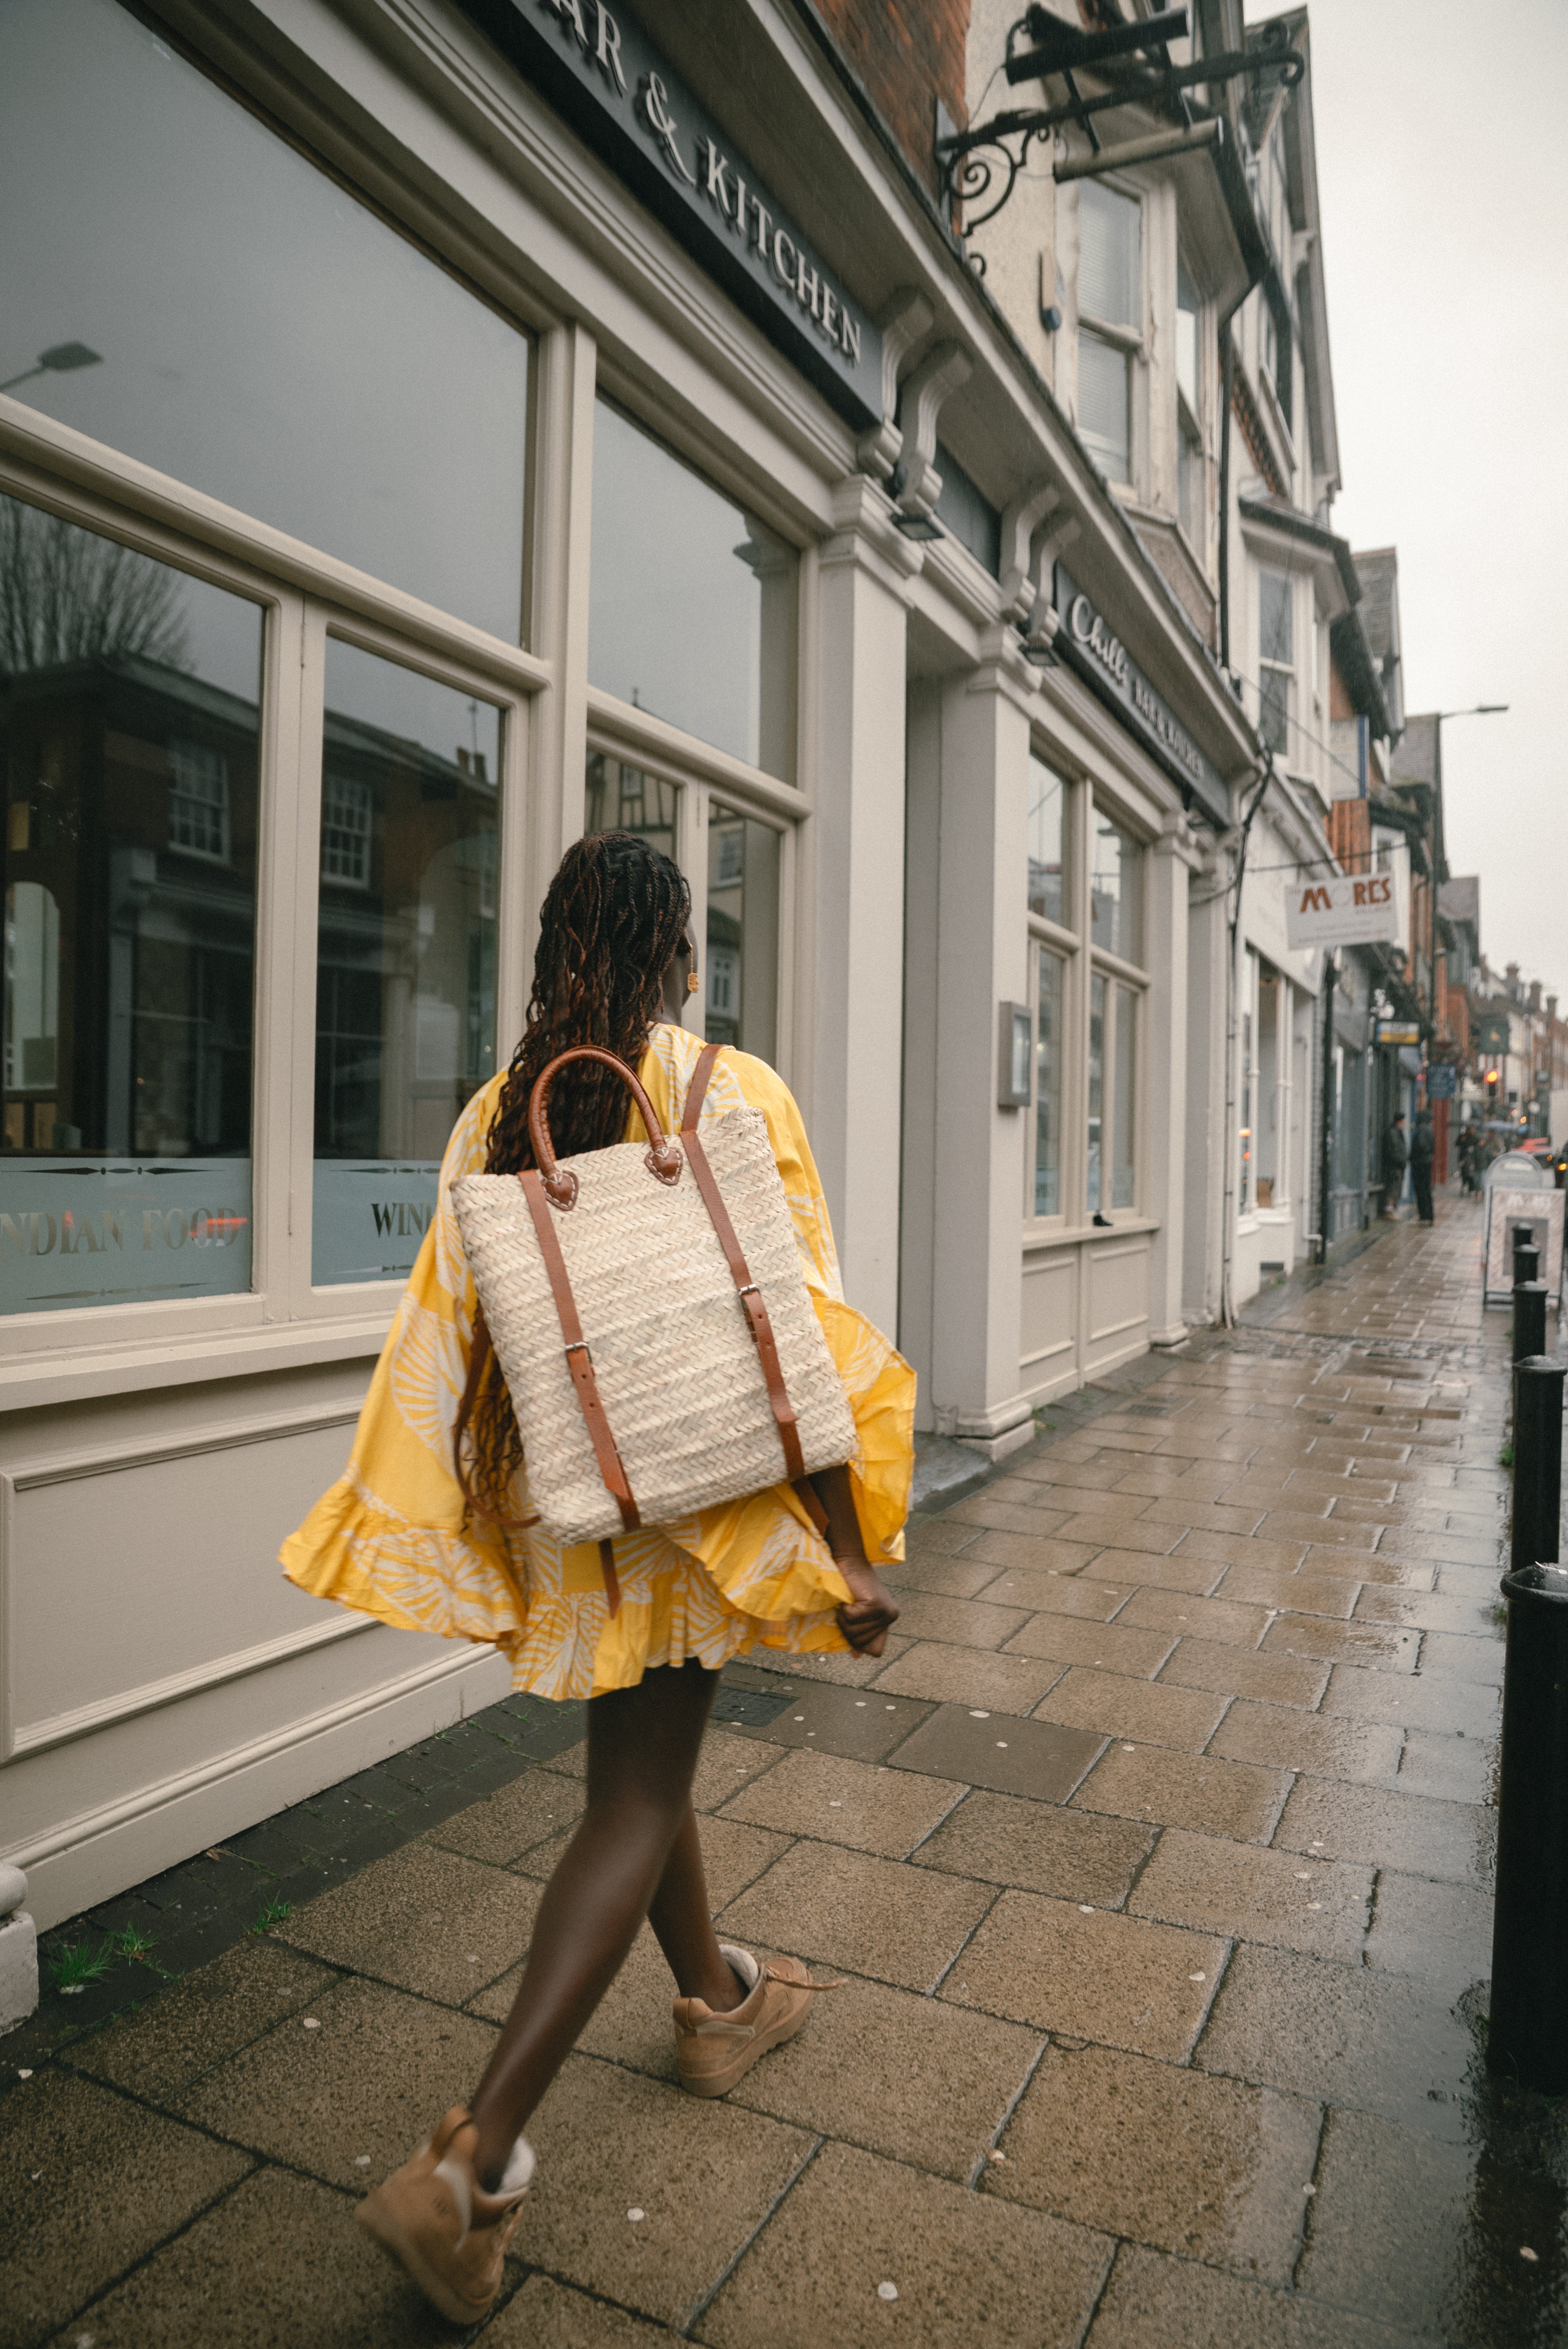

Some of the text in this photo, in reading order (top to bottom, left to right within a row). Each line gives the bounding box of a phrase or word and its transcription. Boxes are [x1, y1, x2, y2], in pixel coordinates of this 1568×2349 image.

[646, 71, 695, 185] &
[705, 135, 860, 365] KITCHEN
[142, 1208, 239, 1250] FOOD
